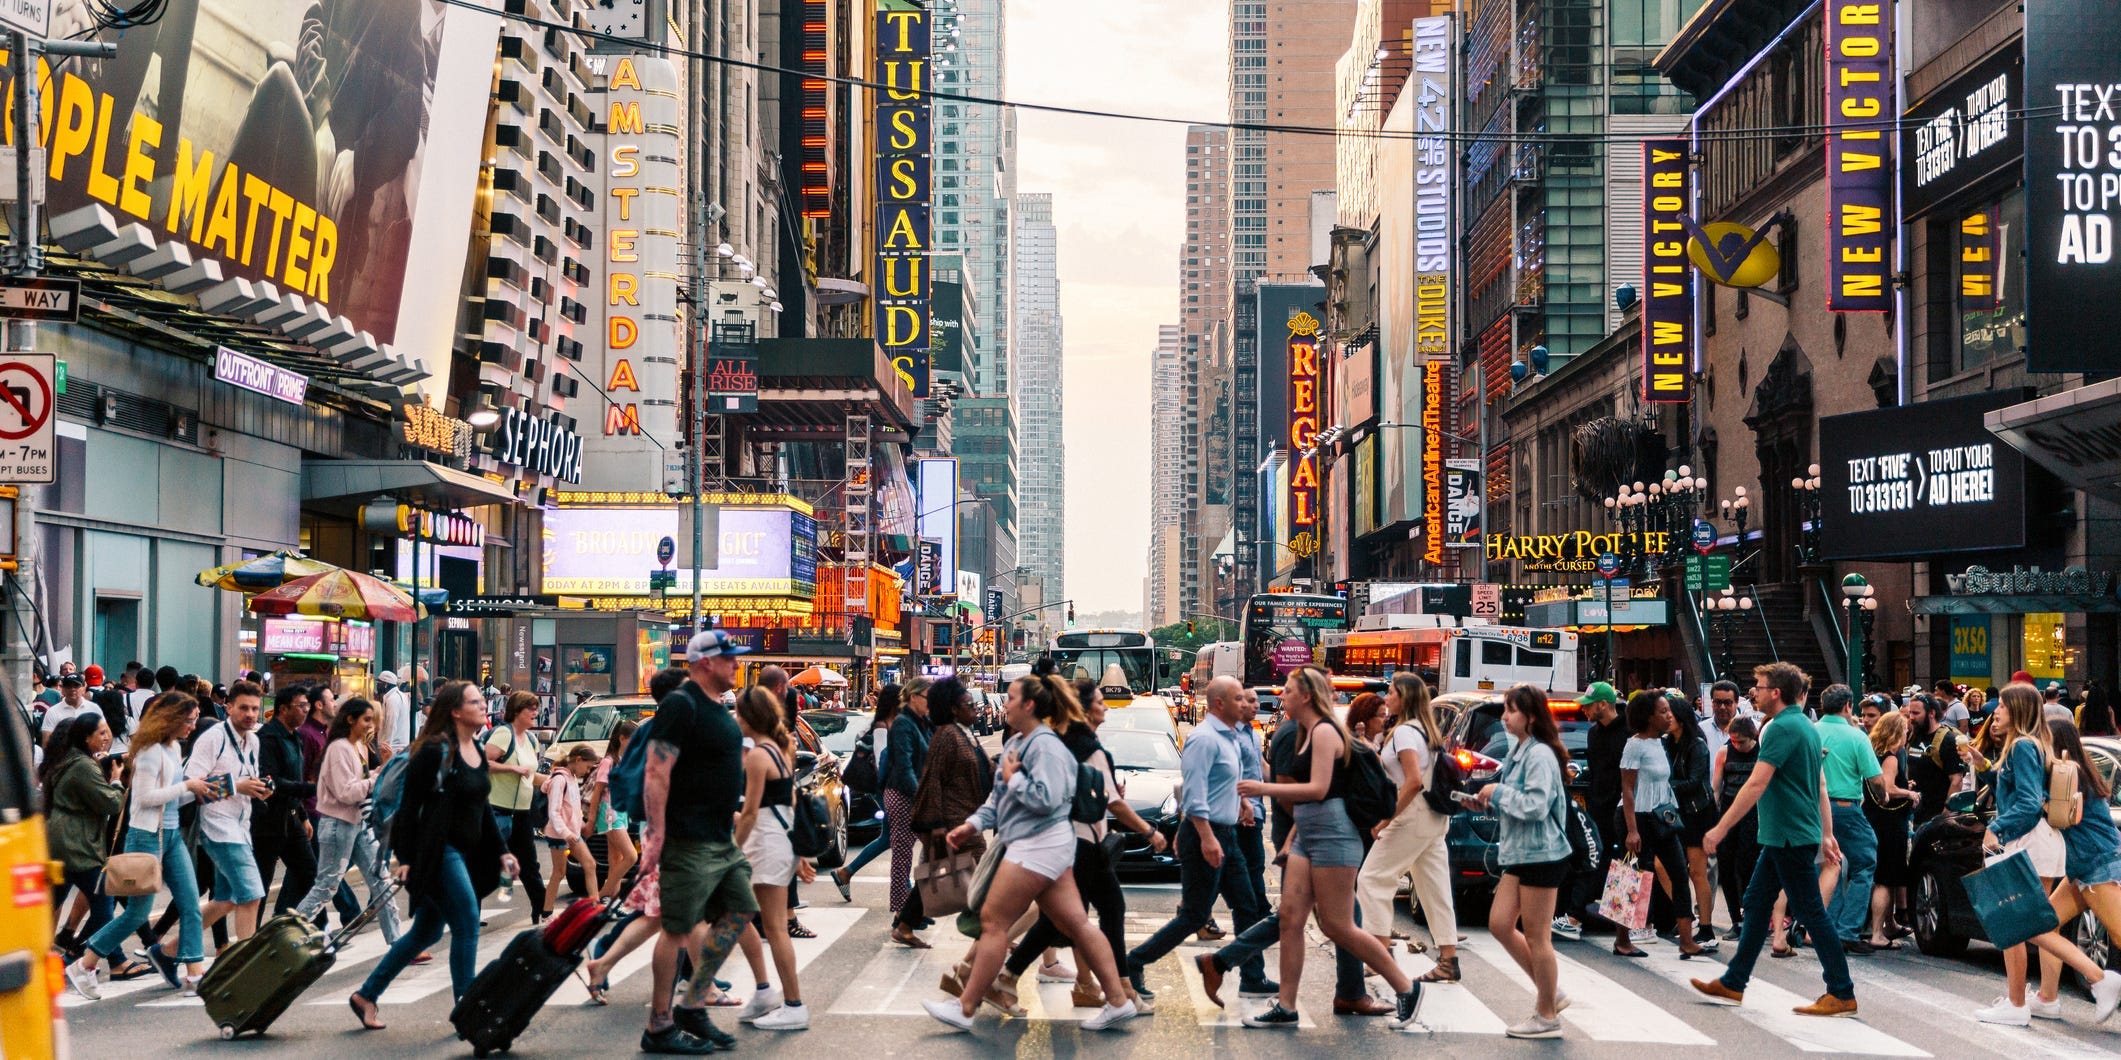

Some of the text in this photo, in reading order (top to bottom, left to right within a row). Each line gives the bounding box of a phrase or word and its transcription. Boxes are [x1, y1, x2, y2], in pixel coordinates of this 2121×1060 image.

[604, 25, 612, 35] 6
[1416, 20, 1446, 73] NEW
[1966, 73, 2007, 120] TO PUT YOUR
[2055, 83, 2121, 122] TEX
[1915, 121, 1934, 157] TEXT
[1966, 102, 2008, 158] AD HERE!
[2055, 125, 2099, 170] TO
[1840, 4, 1882, 297] NEW VICTOR
[1916, 137, 1955, 188] TO 313131
[0, 50, 338, 304] OPLE MATTER
[2056, 173, 2121, 211] TO P
[883, 12, 923, 392] TUSSAUDS
[1416, 168, 1446, 272] STUDIOS
[606, 57, 644, 436] AMSTERDAM
[2057, 213, 2112, 265] AD
[1418, 274, 1446, 284] THE
[1653, 147, 1684, 392] NEW VICTORY
[24, 290, 62, 308] WAY
[1418, 284, 1446, 344] DUKE
[220, 352, 304, 399] OUTFRONT PRIME
[709, 375, 757, 391] RISE
[712, 360, 754, 376] ALL
[503, 407, 584, 485] SEPHORA
[1291, 342, 1317, 525] REGAL
[16, 465, 48, 475] BUSES
[1848, 457, 1876, 483] TEXT
[1928, 450, 1943, 474] TO
[1943, 447, 1962, 472] PUT
[1963, 443, 1993, 470] YOUR
[1447, 474, 1463, 534] DANCE
[1848, 479, 1914, 514] TO 313131
[1928, 469, 1994, 506] AD HERE!
[1486, 533, 1570, 561] HARRY
[920, 544, 932, 589] DANCE
[1540, 563, 1552, 571] THE
[1554, 561, 1596, 572] CURSED
[1965, 564, 2110, 598] Subway
[545, 581, 577, 590] ODAY
[582, 581, 594, 590] AT
[598, 581, 620, 590] 2PM
[623, 581, 631, 590] &
[634, 581, 649, 590] 8P
[675, 581, 709, 590] GRET
[713, 581, 747, 590] SEATS
[1629, 588, 1659, 599] TORY
[987, 592, 995, 621] DANCE
[1475, 601, 1496, 614] 25
[267, 634, 294, 648] MEAN
[295, 635, 322, 650] GIRLS
[518, 626, 526, 669] Newsstand
[1507, 634, 1529, 642] 6736
[1954, 626, 1987, 656] 3XSQ
